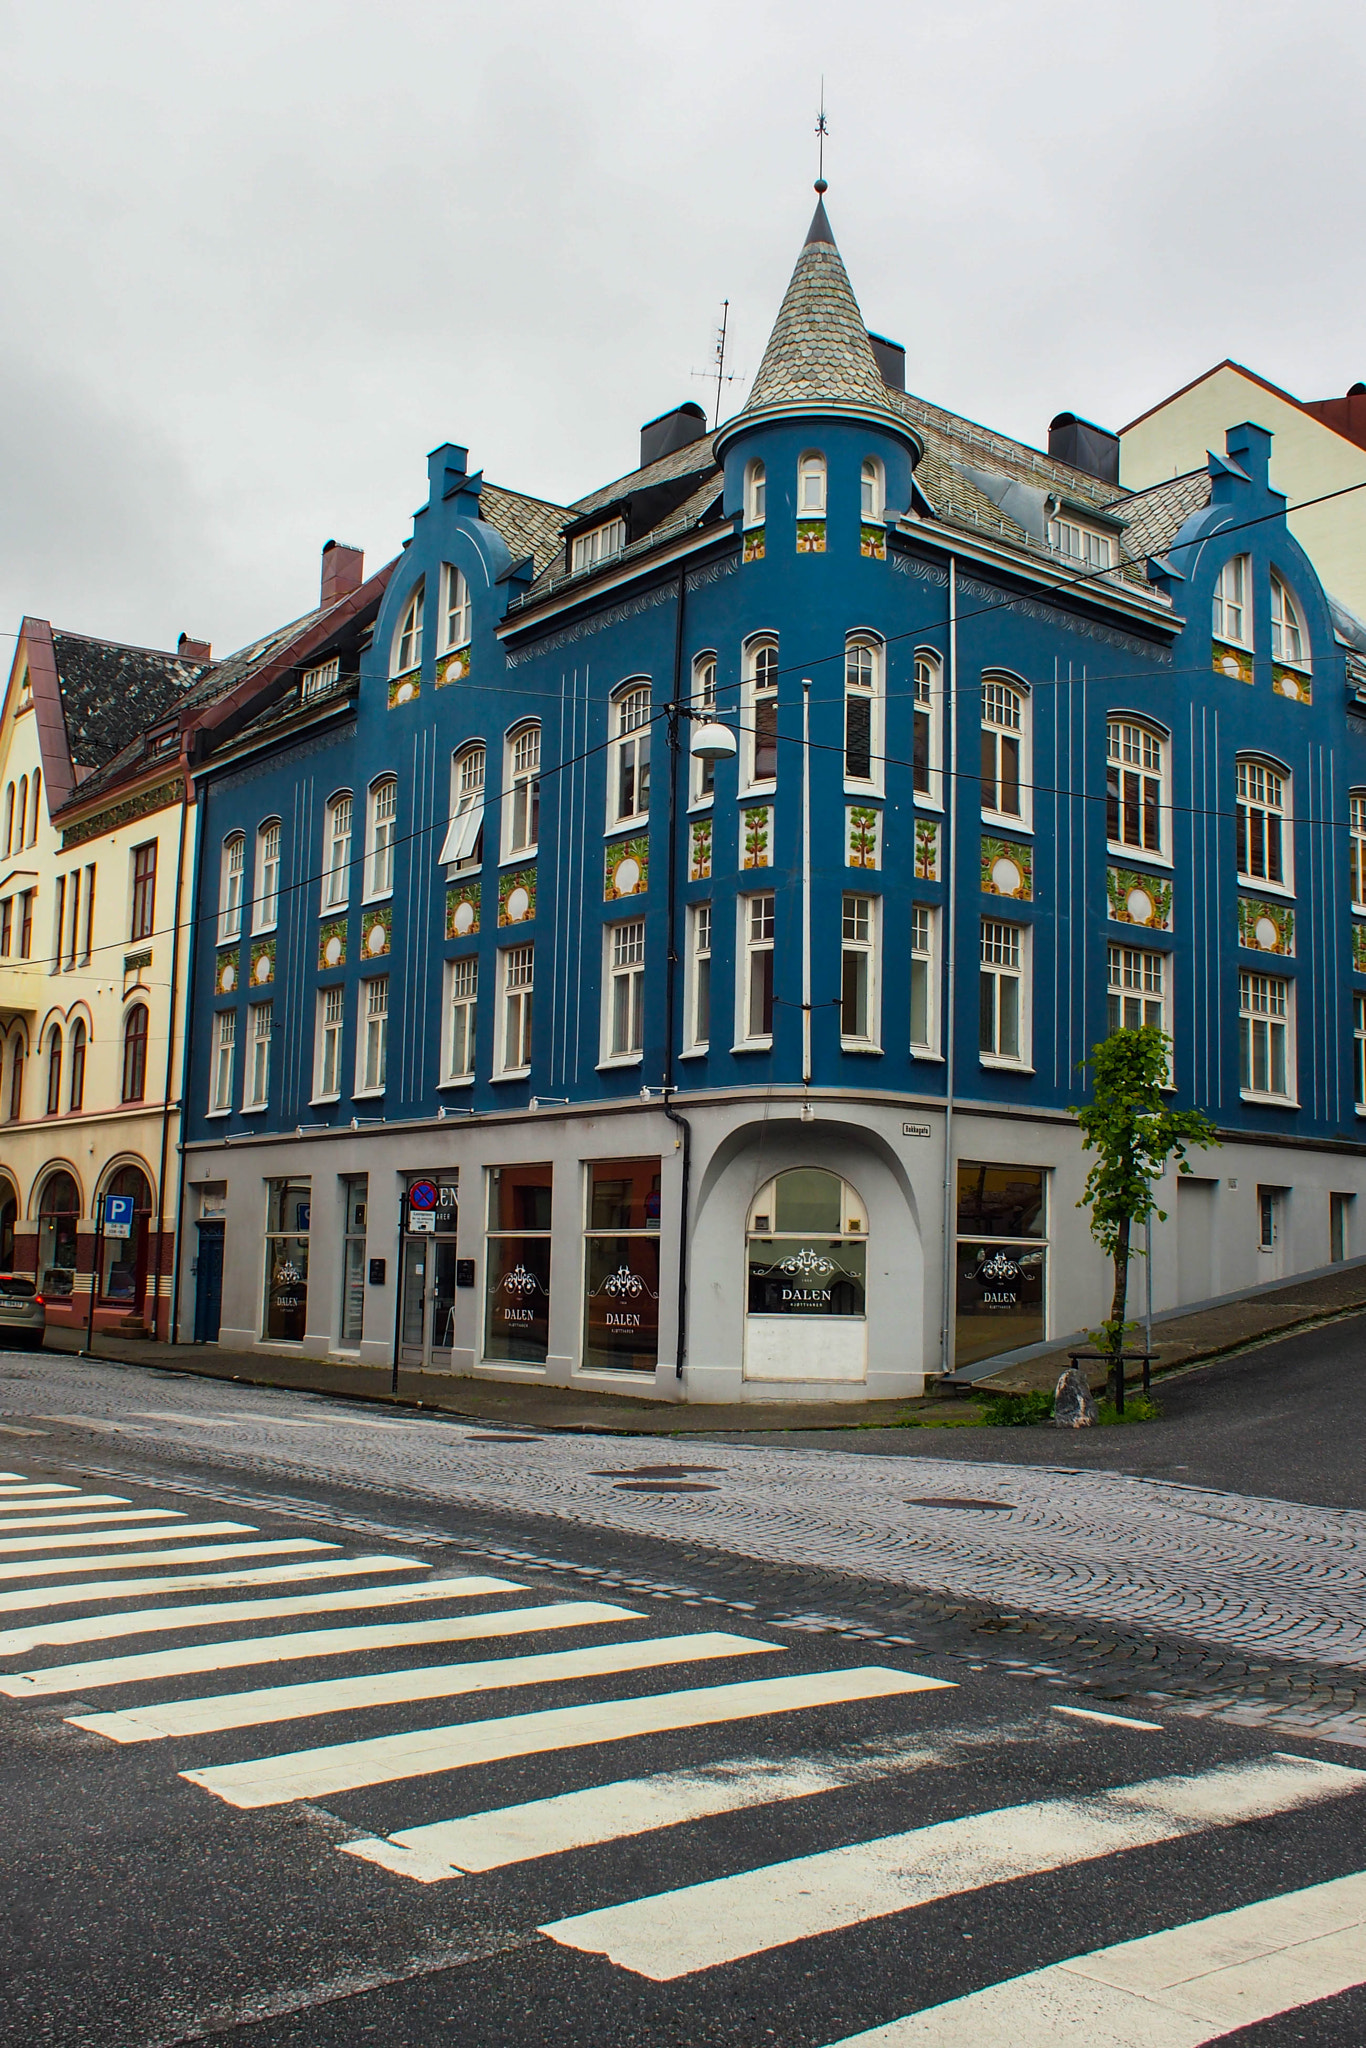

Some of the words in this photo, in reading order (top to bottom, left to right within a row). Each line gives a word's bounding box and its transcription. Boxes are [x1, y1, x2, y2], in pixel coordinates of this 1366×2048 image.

[111, 1200, 126, 1220] P
[782, 1289, 831, 1300] DALEN
[984, 1292, 1016, 1303] DALEN
[277, 1296, 298, 1306] DALEN
[504, 1308, 534, 1320] DALEN
[606, 1313, 640, 1326] DALEN
